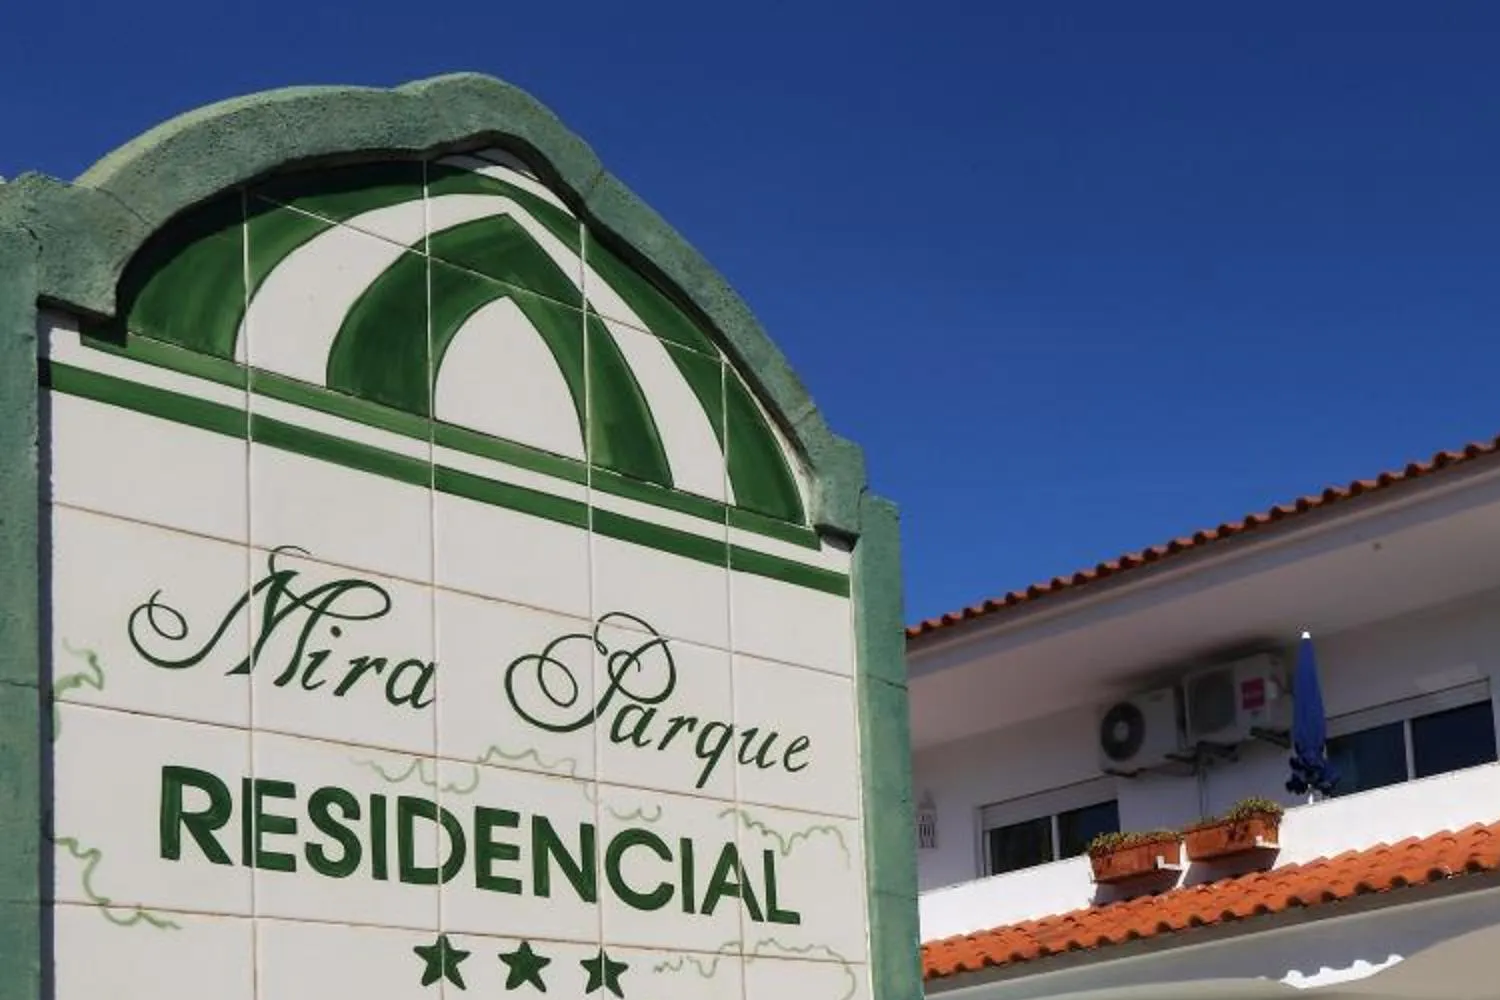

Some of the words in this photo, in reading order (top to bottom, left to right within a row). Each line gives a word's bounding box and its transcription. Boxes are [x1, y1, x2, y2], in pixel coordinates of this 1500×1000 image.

[128, 545, 437, 711] Mira
[505, 611, 811, 789] Parque
[159, 764, 802, 926] RESIDENCIAL
